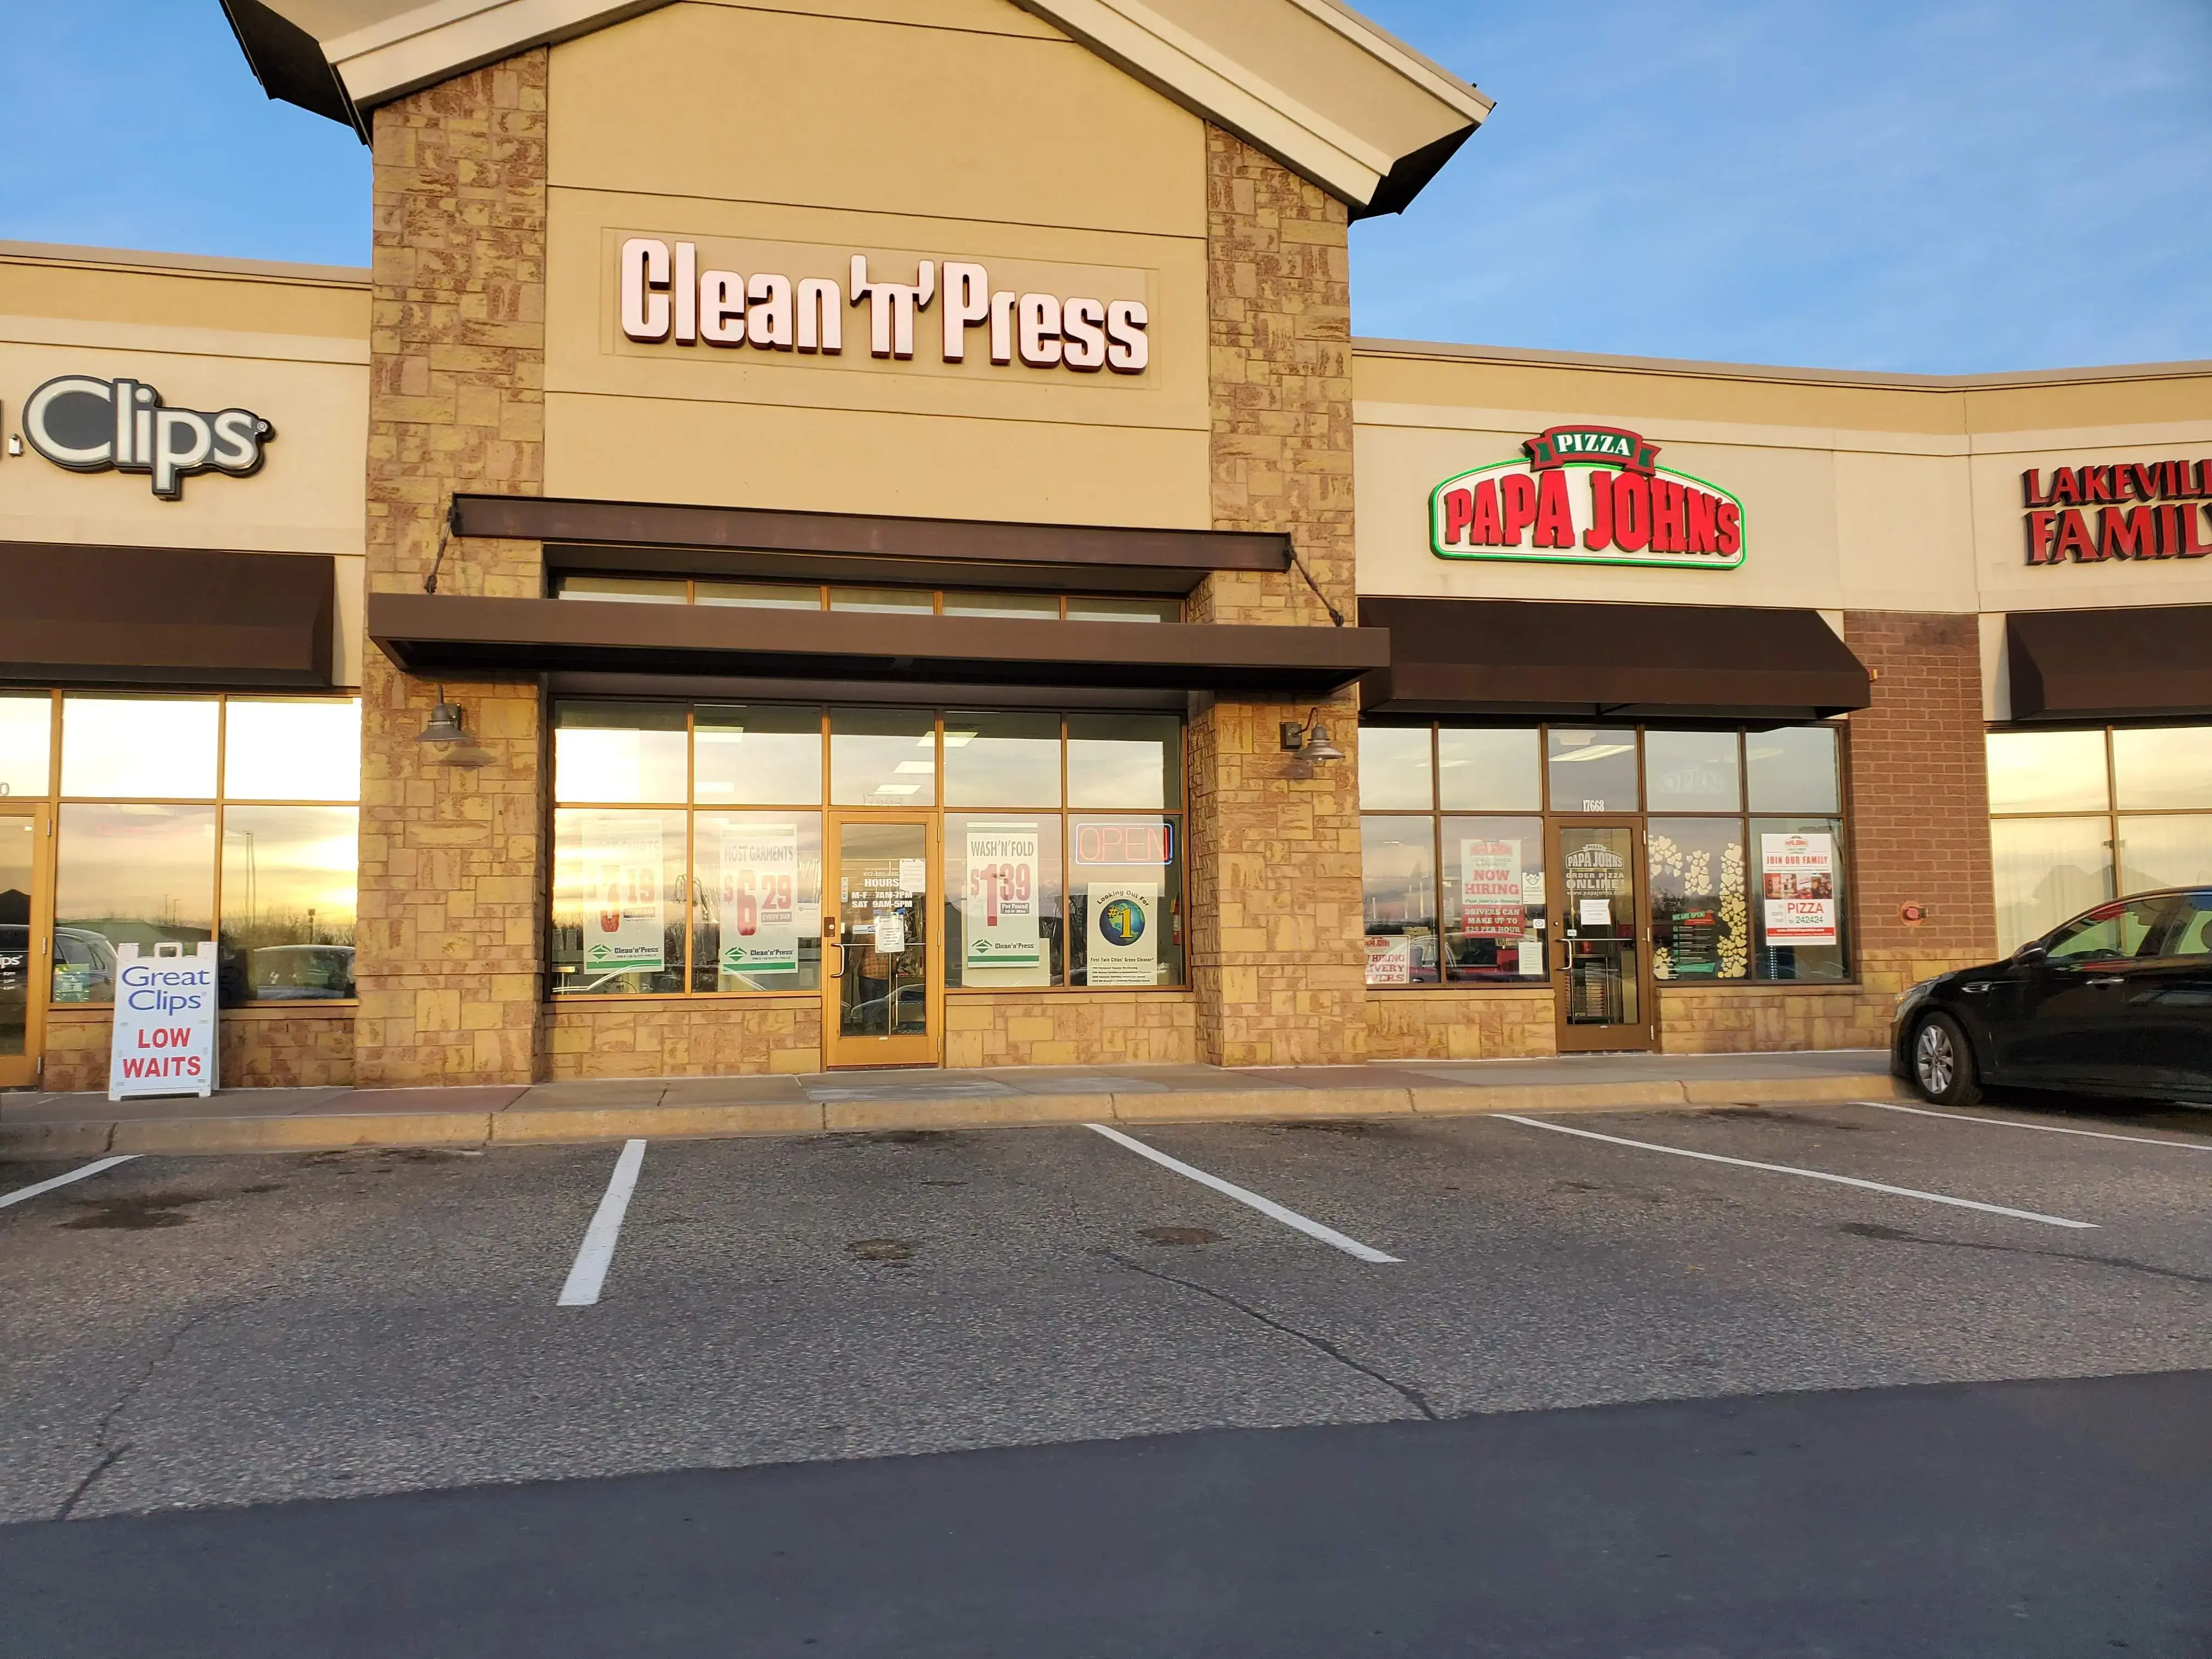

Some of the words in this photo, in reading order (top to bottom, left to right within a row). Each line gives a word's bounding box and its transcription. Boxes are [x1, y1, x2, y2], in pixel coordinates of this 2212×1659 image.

[941, 261, 1149, 375] Press
[23, 375, 269, 495] Clips
[1556, 433, 1632, 456] PIZZA
[1444, 470, 1576, 549] PAPA
[2023, 503, 2212, 566] FAMIL
[1582, 799, 1604, 812] 17668
[724, 845, 748, 861] MOST
[749, 845, 793, 861] GARMENTS
[1080, 827, 1169, 861] OPEN
[1567, 851, 1592, 867] PAPA
[1766, 856, 1783, 865] JOIN
[1785, 856, 1800, 865] OUR
[1802, 856, 1828, 865] FAMILY
[865, 878, 900, 887] HOURS
[1473, 869, 1510, 881] NOW
[1097, 890, 1124, 905] Looking
[1126, 890, 1138, 899] Out
[1139, 896, 1149, 906] For
[1464, 883, 1519, 895] HIRING
[1787, 902, 1825, 914] PIZZA
[1795, 916, 1824, 924] 242424
[121, 966, 211, 987] Great
[128, 989, 202, 1016] Clips
[137, 1027, 191, 1049] LOW
[122, 1056, 201, 1079] WAITS
